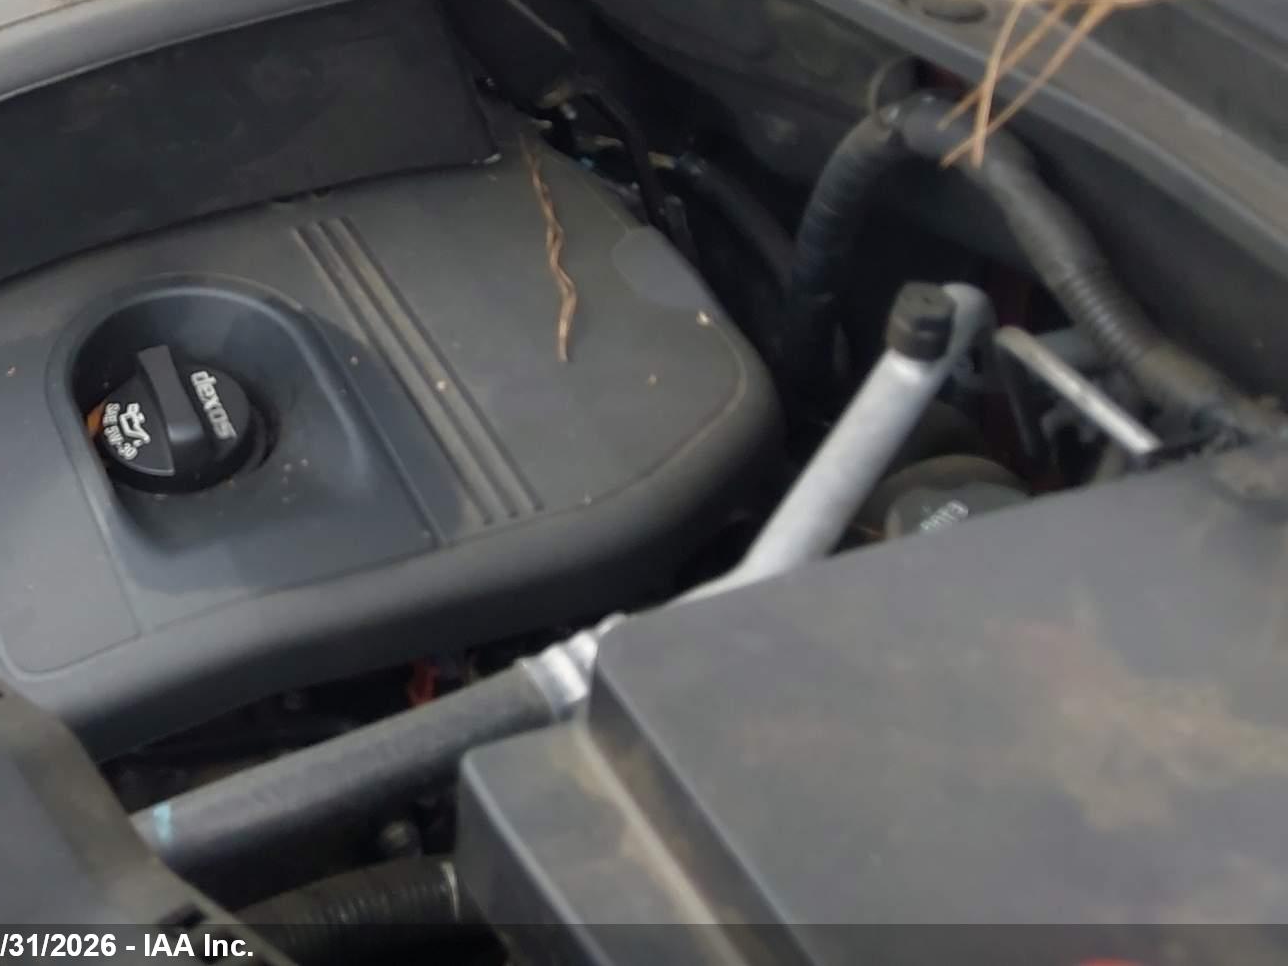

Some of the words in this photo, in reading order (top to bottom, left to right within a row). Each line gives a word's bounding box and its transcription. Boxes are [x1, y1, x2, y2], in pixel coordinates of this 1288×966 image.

[103, 402, 120, 426] SAE
[190, 370, 237, 440] dexos
[104, 425, 138, 460] 5W-30
